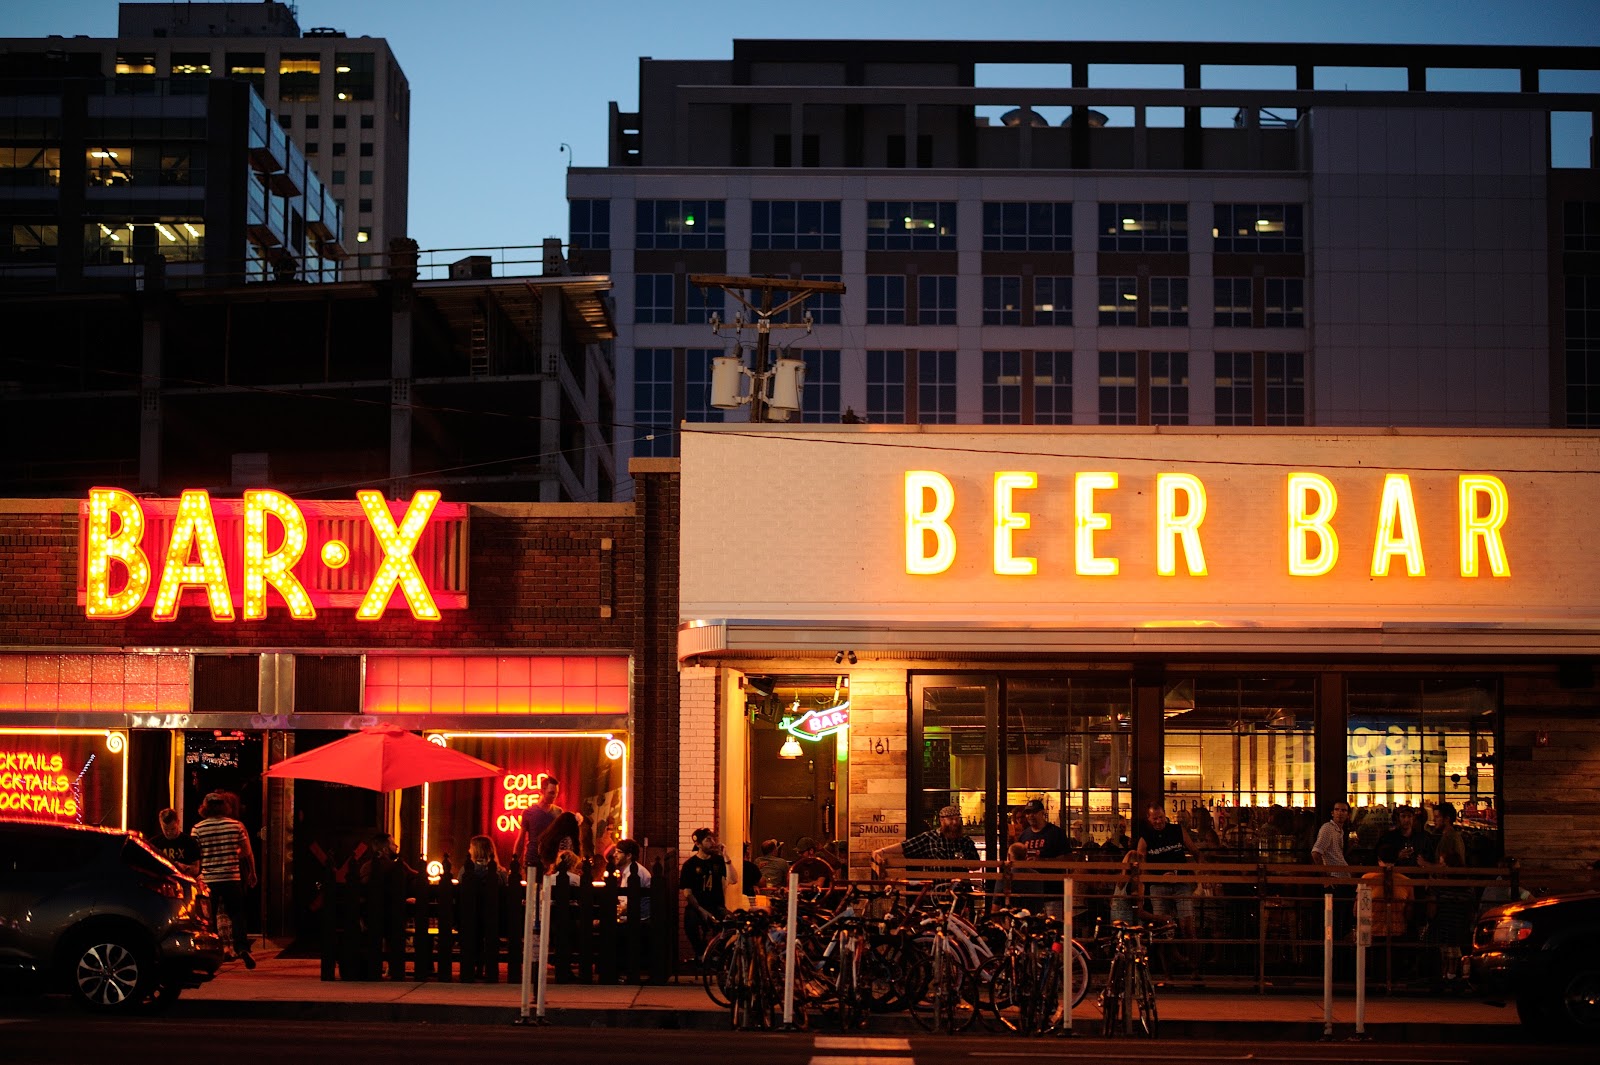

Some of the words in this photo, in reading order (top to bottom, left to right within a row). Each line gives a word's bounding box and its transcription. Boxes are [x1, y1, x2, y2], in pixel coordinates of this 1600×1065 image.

[905, 471, 1208, 576] BEER
[1287, 472, 1511, 577] BAR
[869, 737, 889, 755] 161
[0, 791, 77, 817] OCKTAILS
[504, 794, 543, 811] BEE
[873, 814, 885, 822] NO
[860, 824, 899, 834] SMOKING
